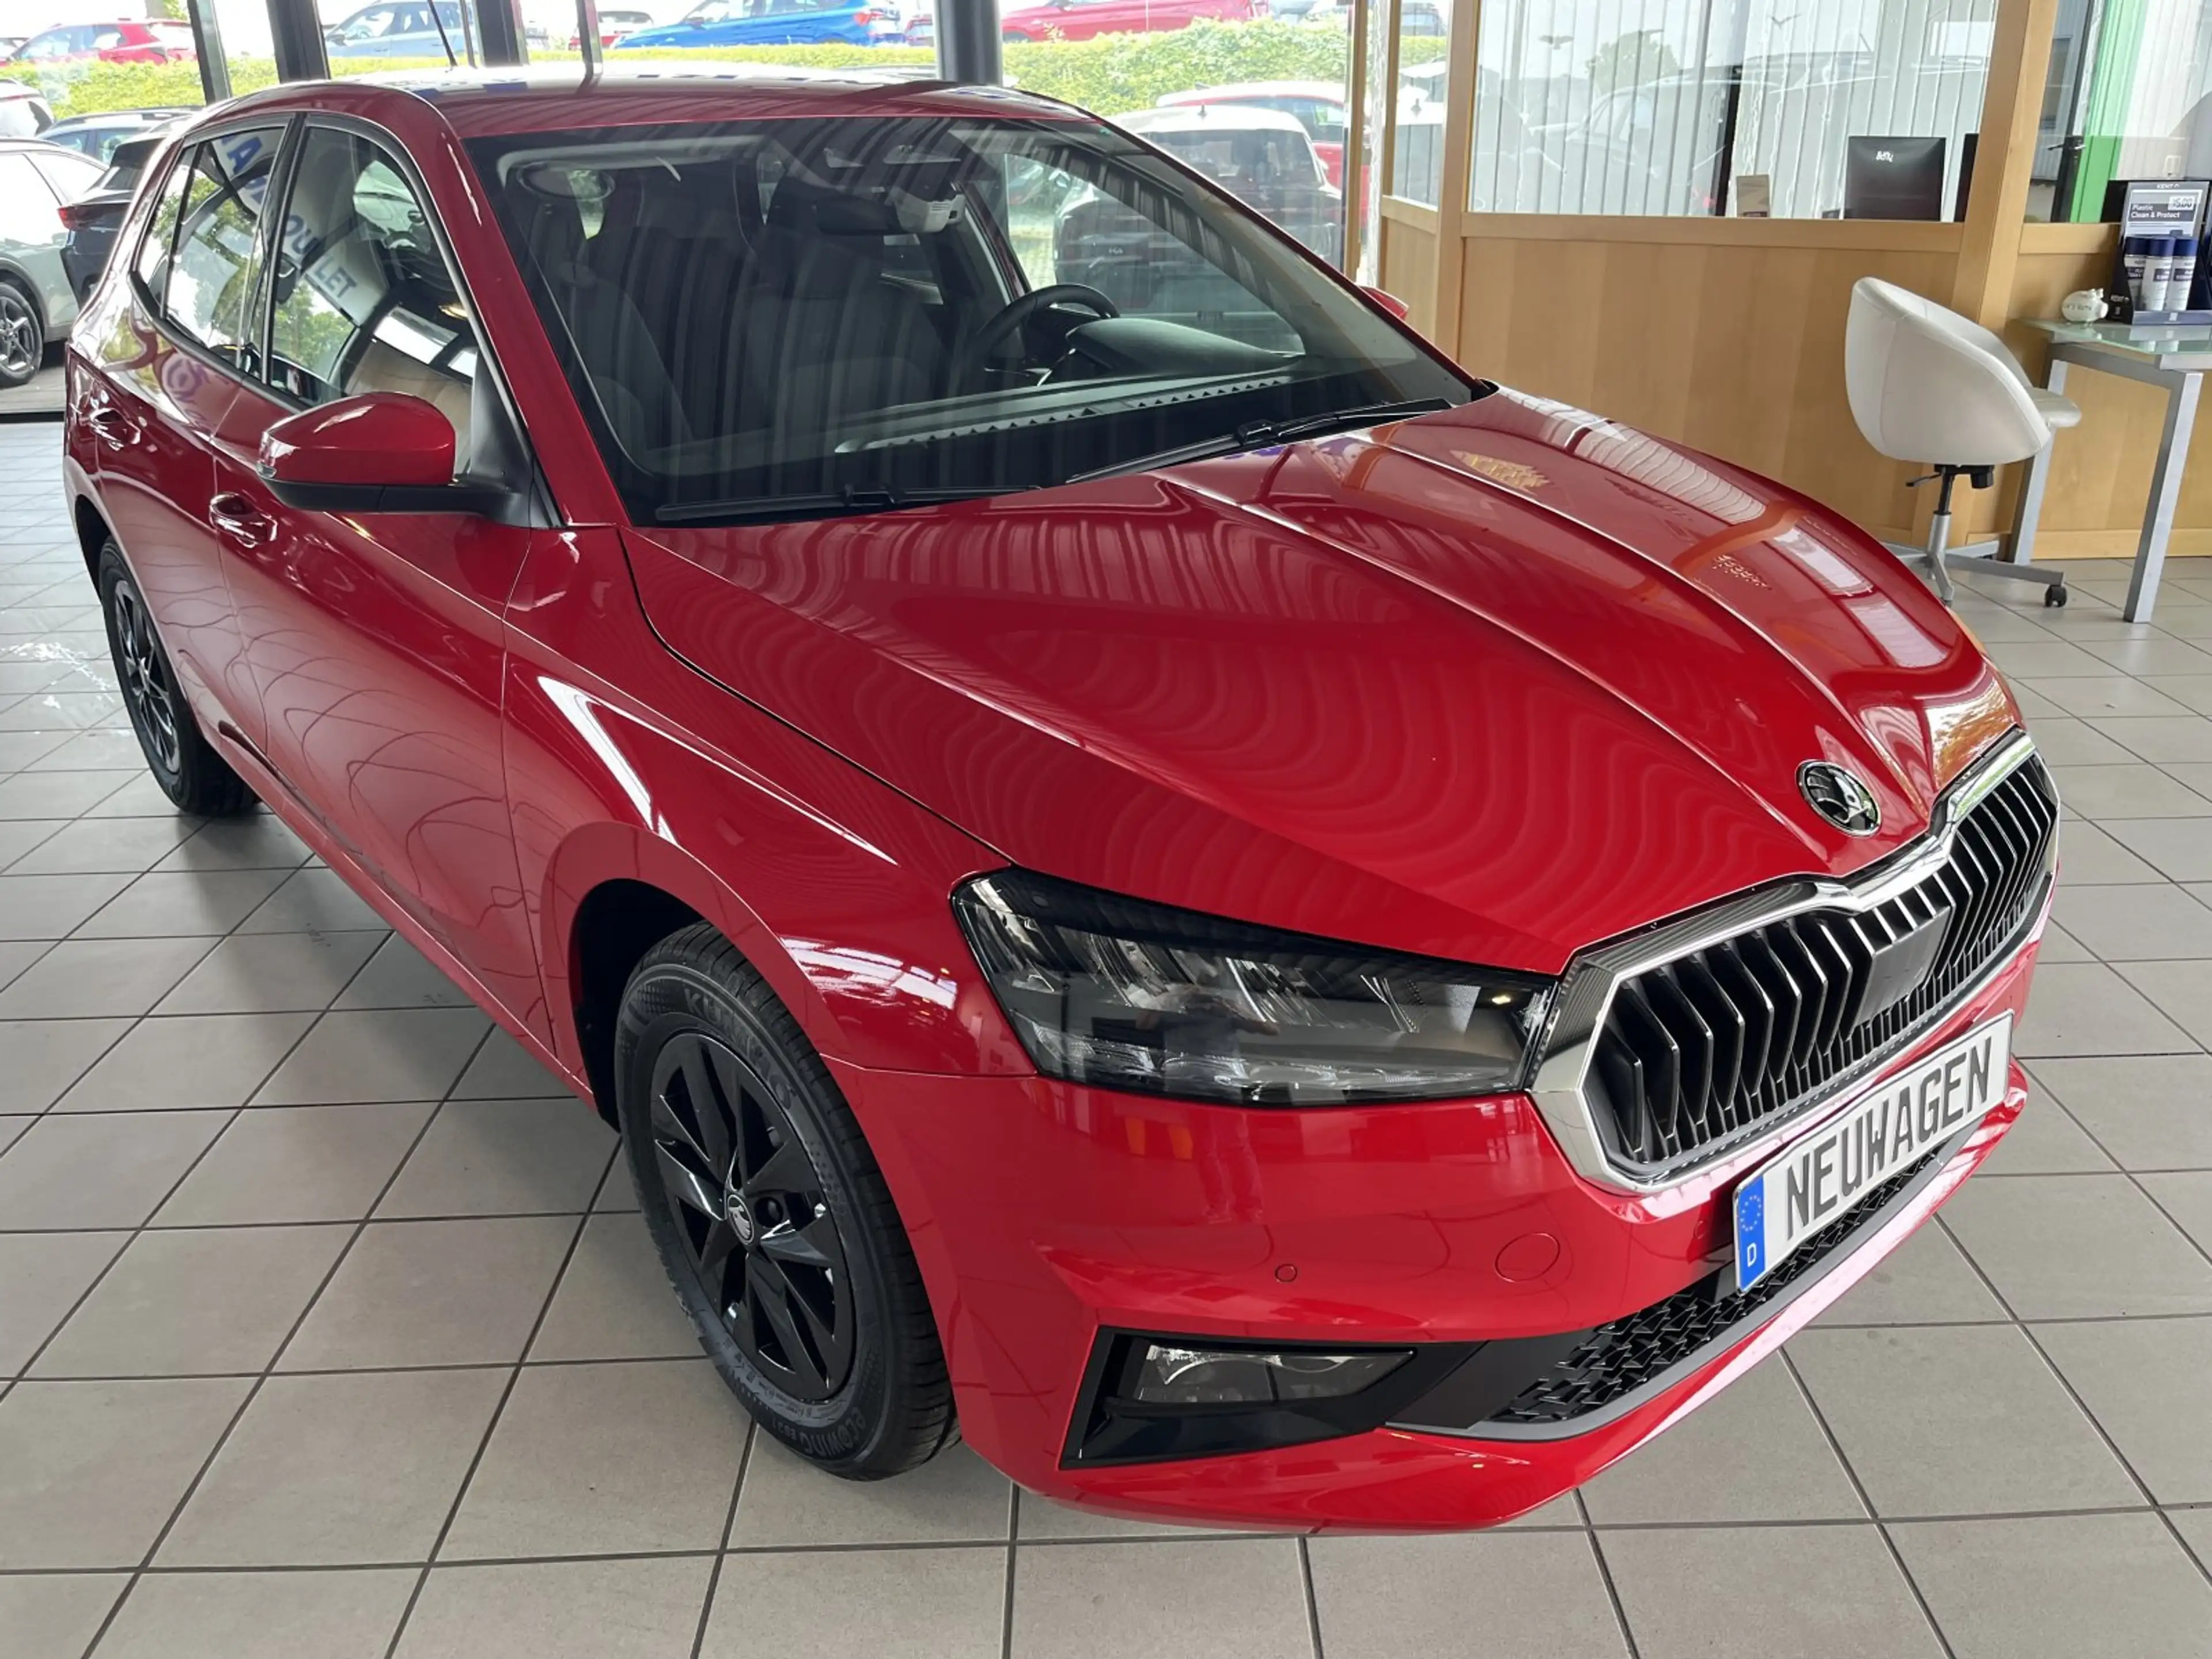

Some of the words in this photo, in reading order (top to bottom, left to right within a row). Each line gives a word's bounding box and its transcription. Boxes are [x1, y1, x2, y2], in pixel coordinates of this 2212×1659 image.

[287, 214, 357, 298] OULET
[1787, 1036, 1992, 1241] NEUWAGEN
[1747, 1243, 1757, 1267] D
